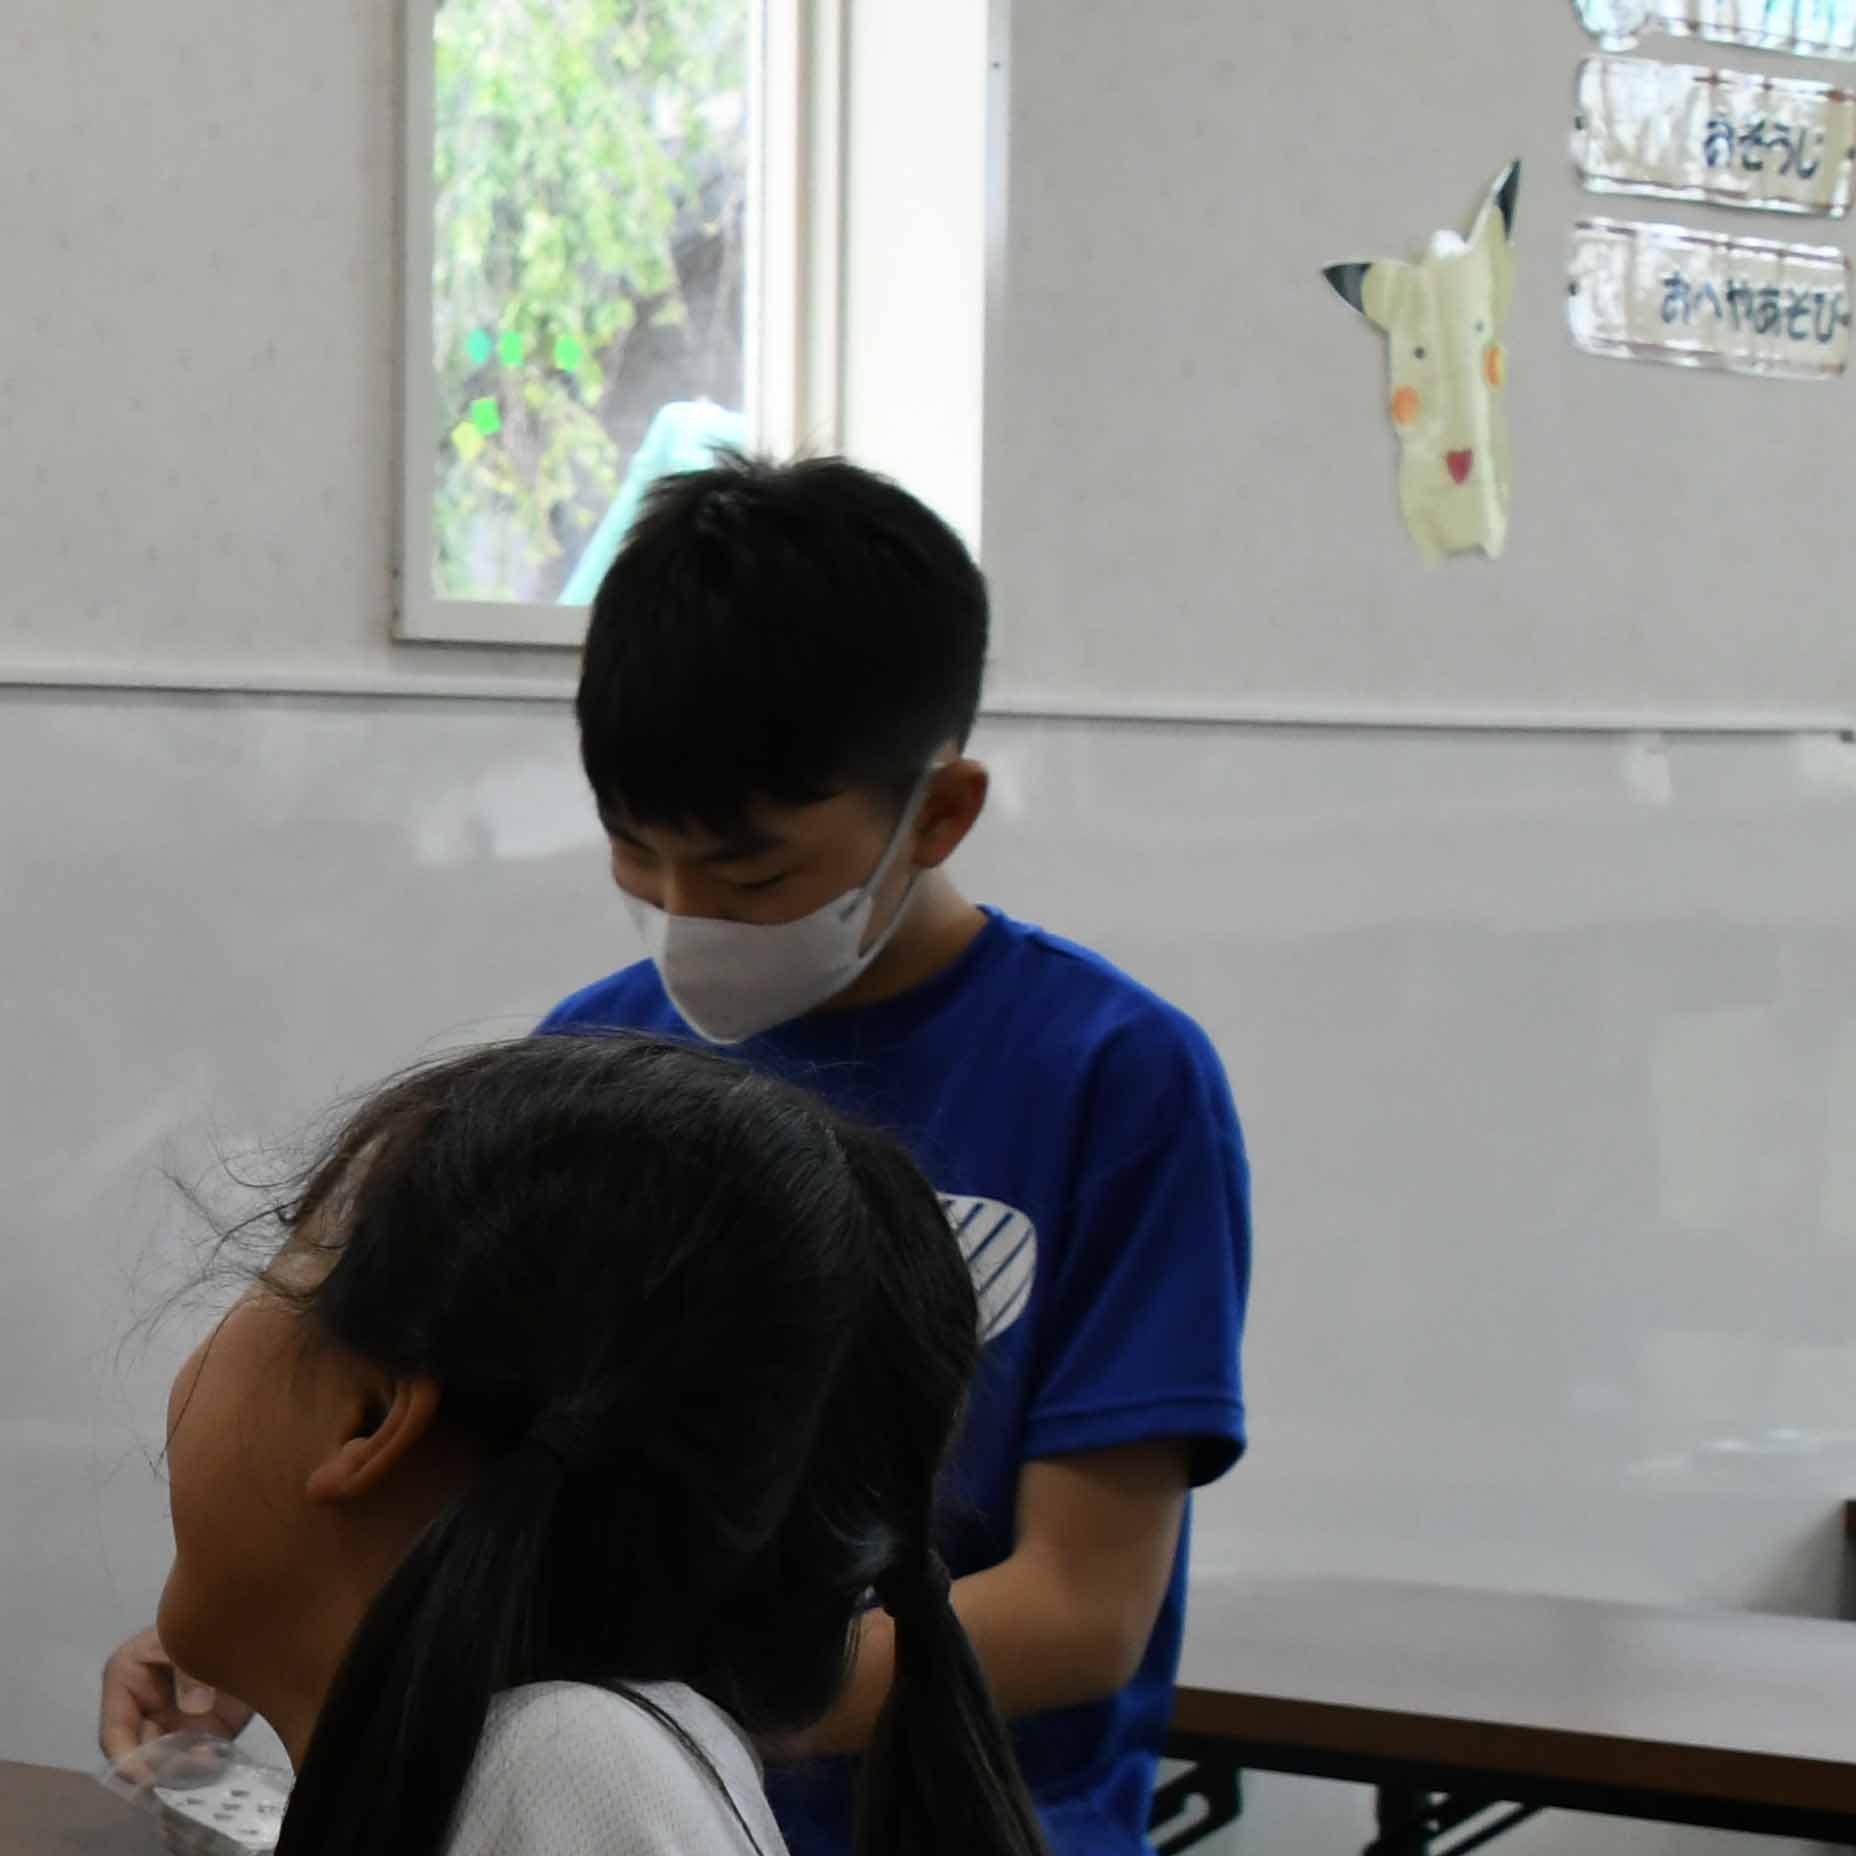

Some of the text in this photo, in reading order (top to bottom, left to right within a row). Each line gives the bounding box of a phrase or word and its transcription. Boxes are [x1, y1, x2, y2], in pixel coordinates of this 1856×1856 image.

[1704, 113, 1825, 179] おそうじ
[1661, 272, 1839, 343] おへやあそび
